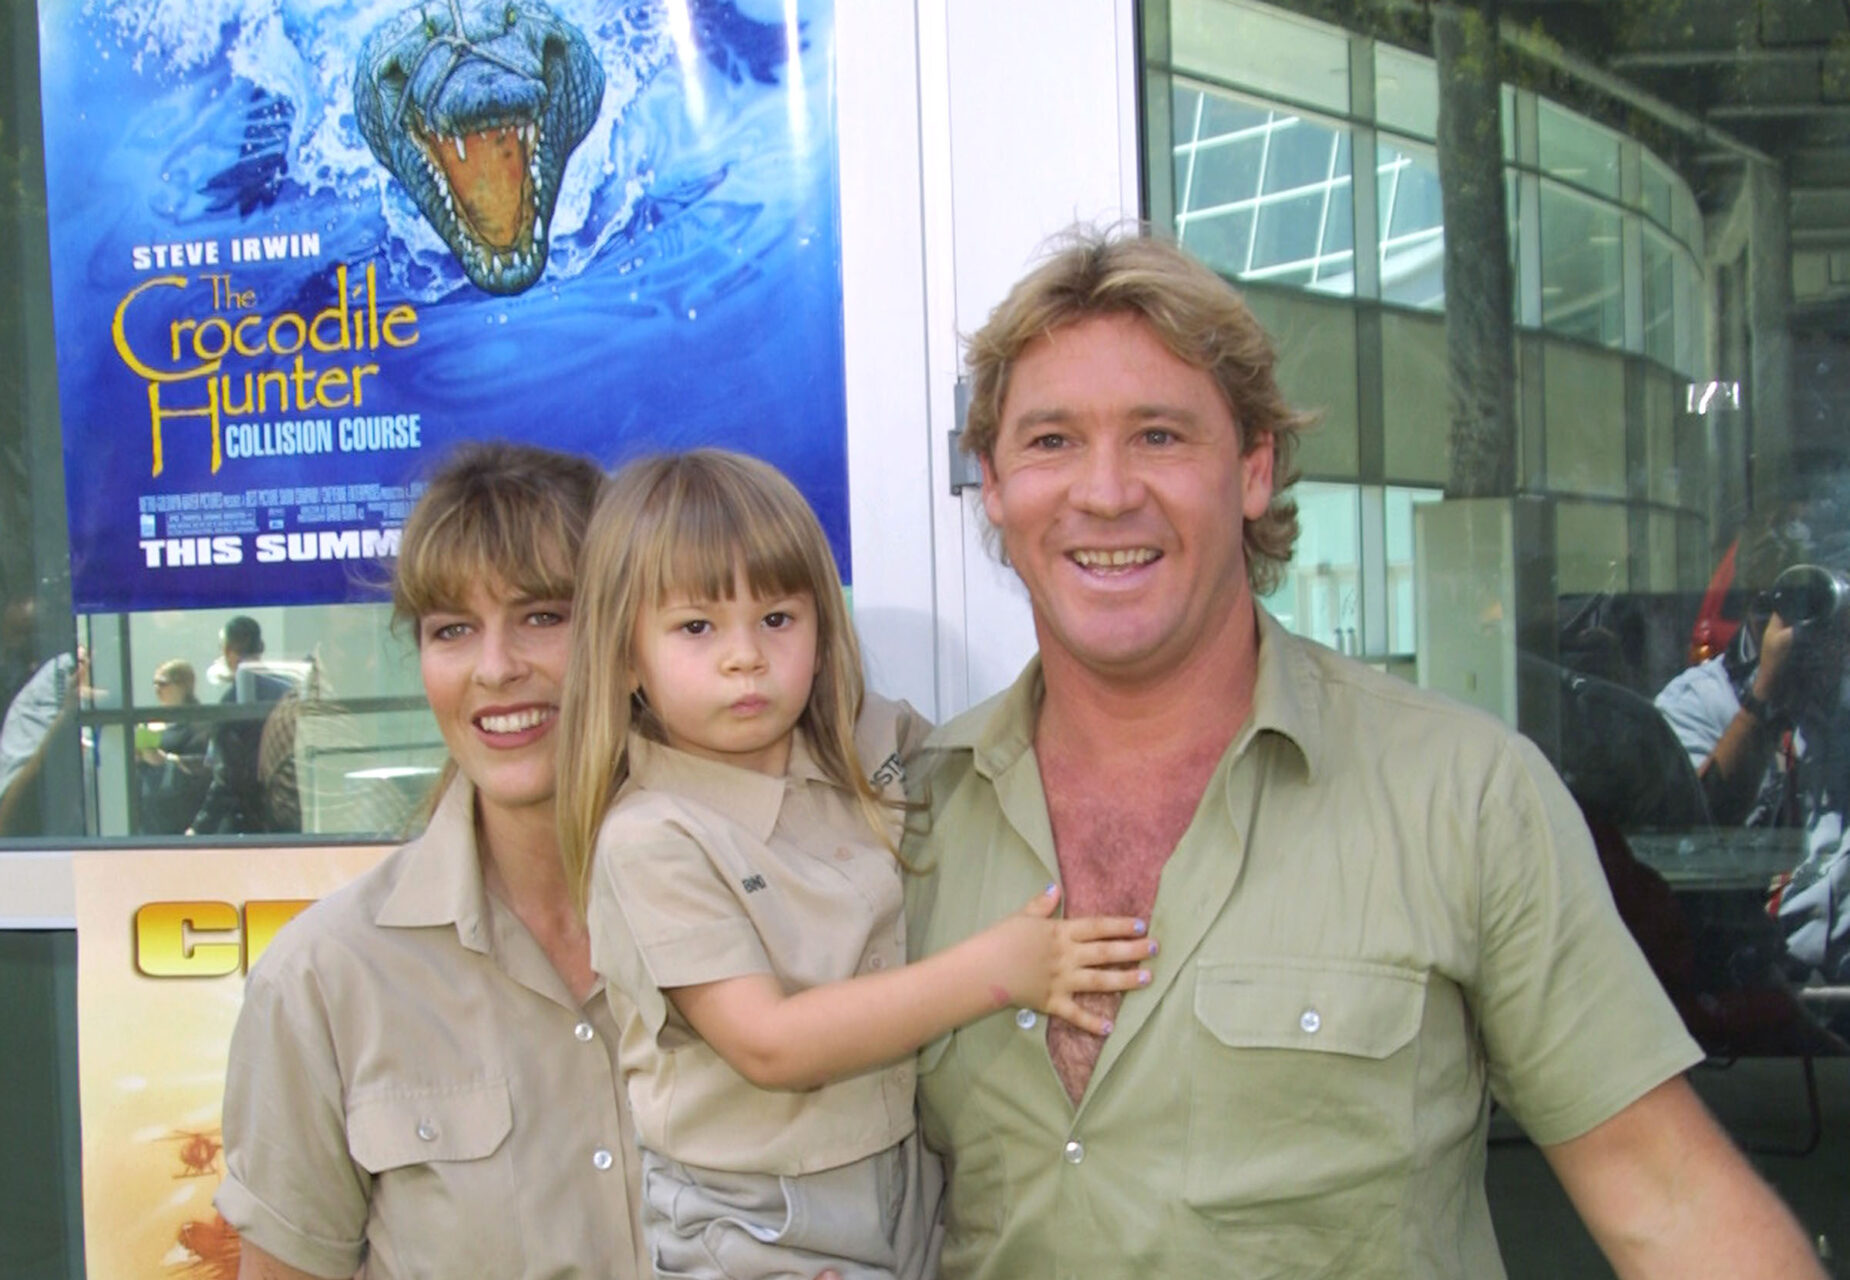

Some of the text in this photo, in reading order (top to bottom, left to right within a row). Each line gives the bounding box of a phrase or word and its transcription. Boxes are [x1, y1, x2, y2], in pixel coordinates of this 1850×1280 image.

[132, 233, 320, 270] STEVE IRWIN
[199, 273, 257, 310] The
[111, 262, 420, 382] Crocodile
[148, 355, 380, 478] Hunter
[225, 414, 422, 459] COLLISION COURSE
[139, 535, 243, 568] THIS
